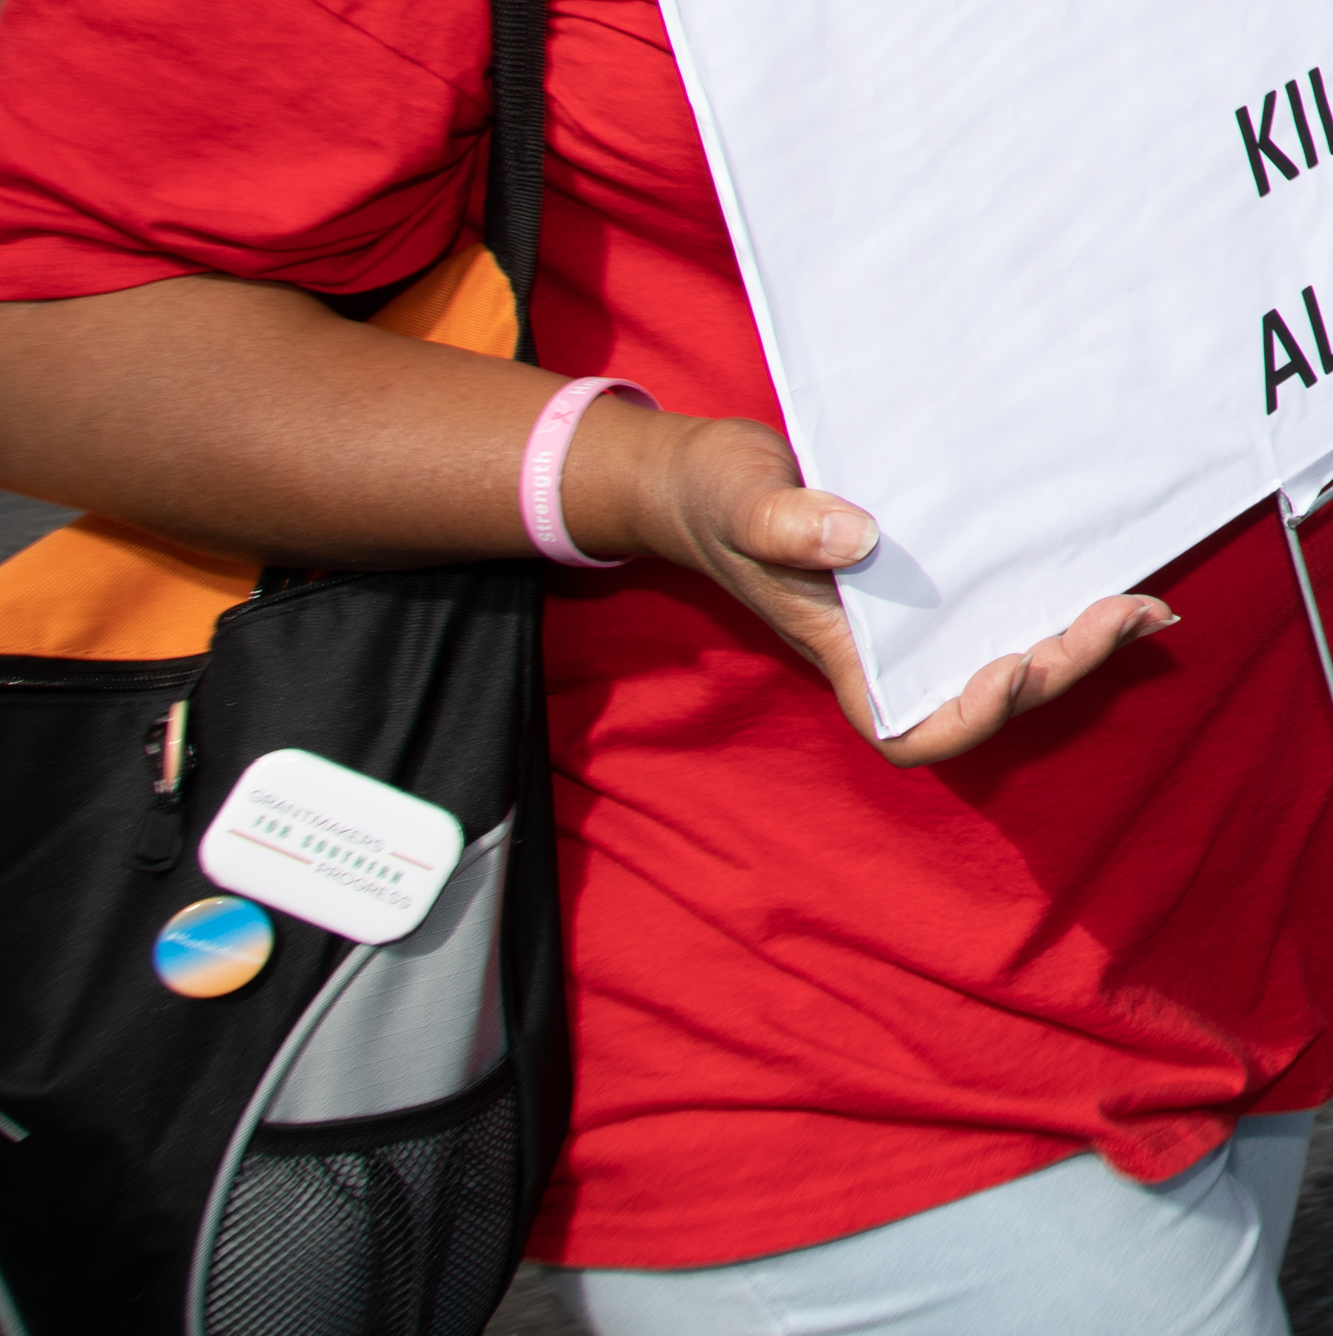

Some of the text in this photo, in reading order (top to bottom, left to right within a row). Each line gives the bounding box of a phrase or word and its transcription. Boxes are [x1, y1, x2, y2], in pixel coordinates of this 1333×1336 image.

[531, 451, 557, 543] Strength
[250, 789, 384, 853] GRANTMAKERS
[252, 815, 404, 885] FOR SOUTHERN
[315, 862, 413, 910] PROGRESS
